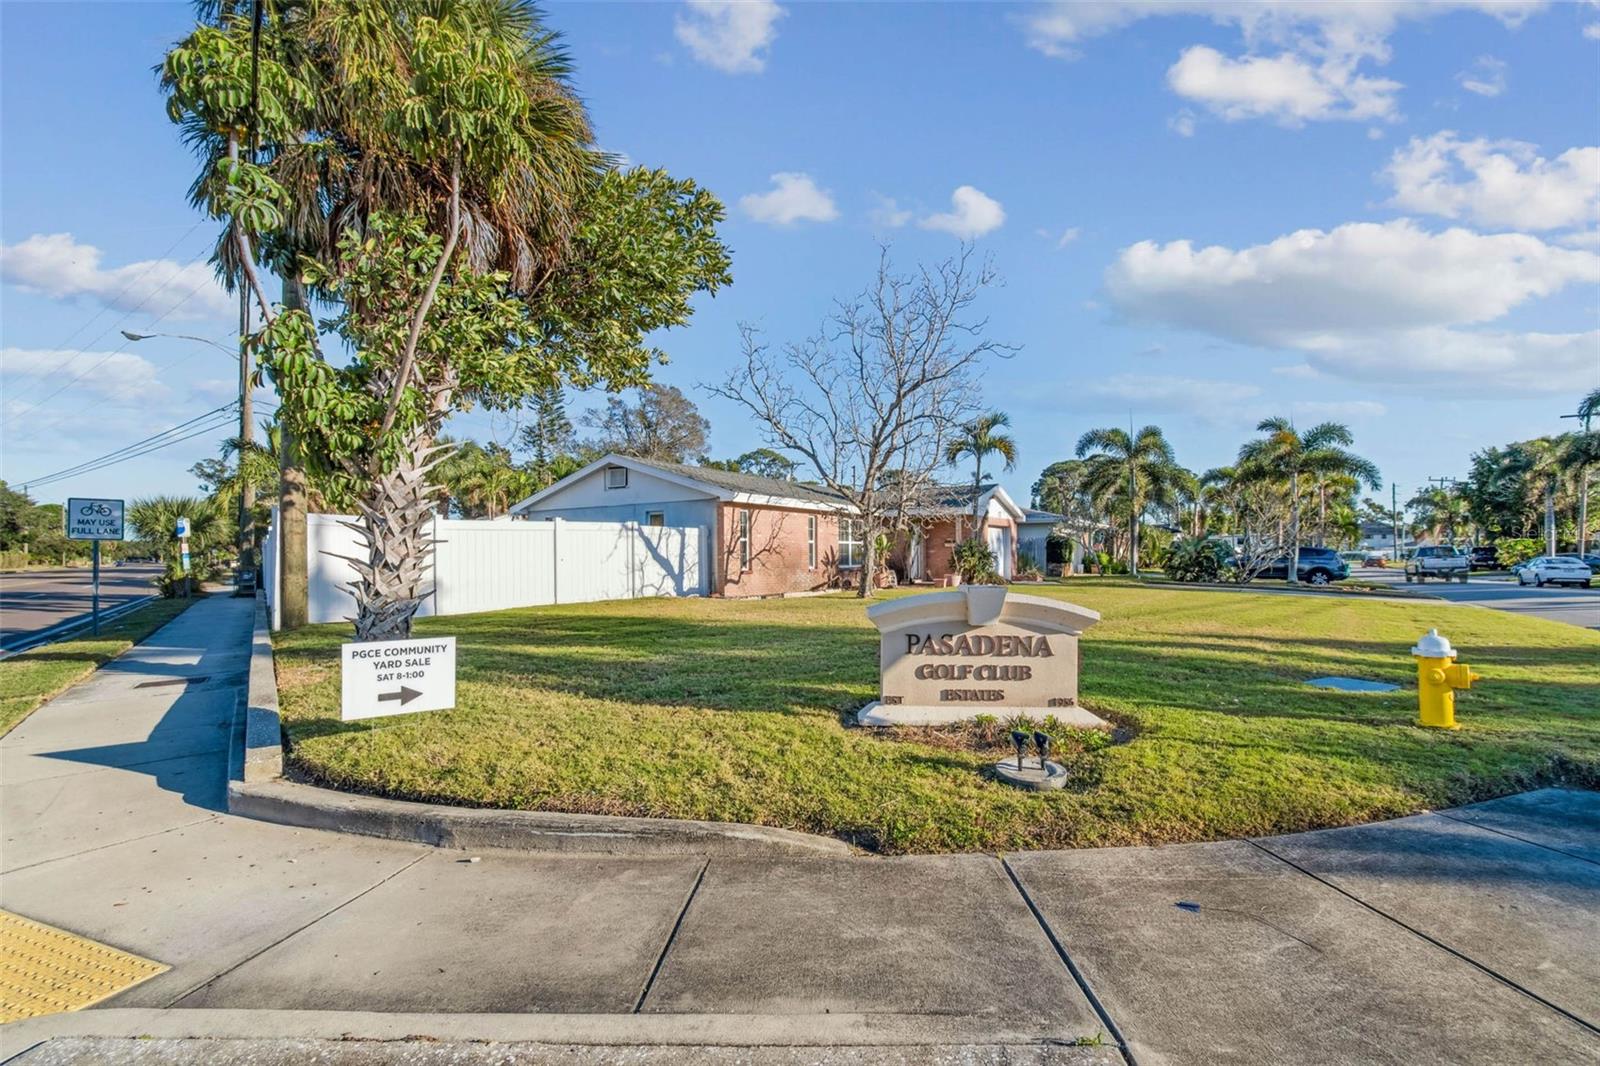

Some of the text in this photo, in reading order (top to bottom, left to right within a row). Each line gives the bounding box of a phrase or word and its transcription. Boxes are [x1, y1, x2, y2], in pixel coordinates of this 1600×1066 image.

[905, 633, 1055, 657] PASADENA
[352, 645, 447, 659] PGCE COMMUNITY
[373, 657, 431, 670] YARD SALE
[377, 670, 425, 682] SAT 8-1:00
[916, 664, 1032, 681] GOLF CLUB
[943, 689, 1005, 702] ESTATES
